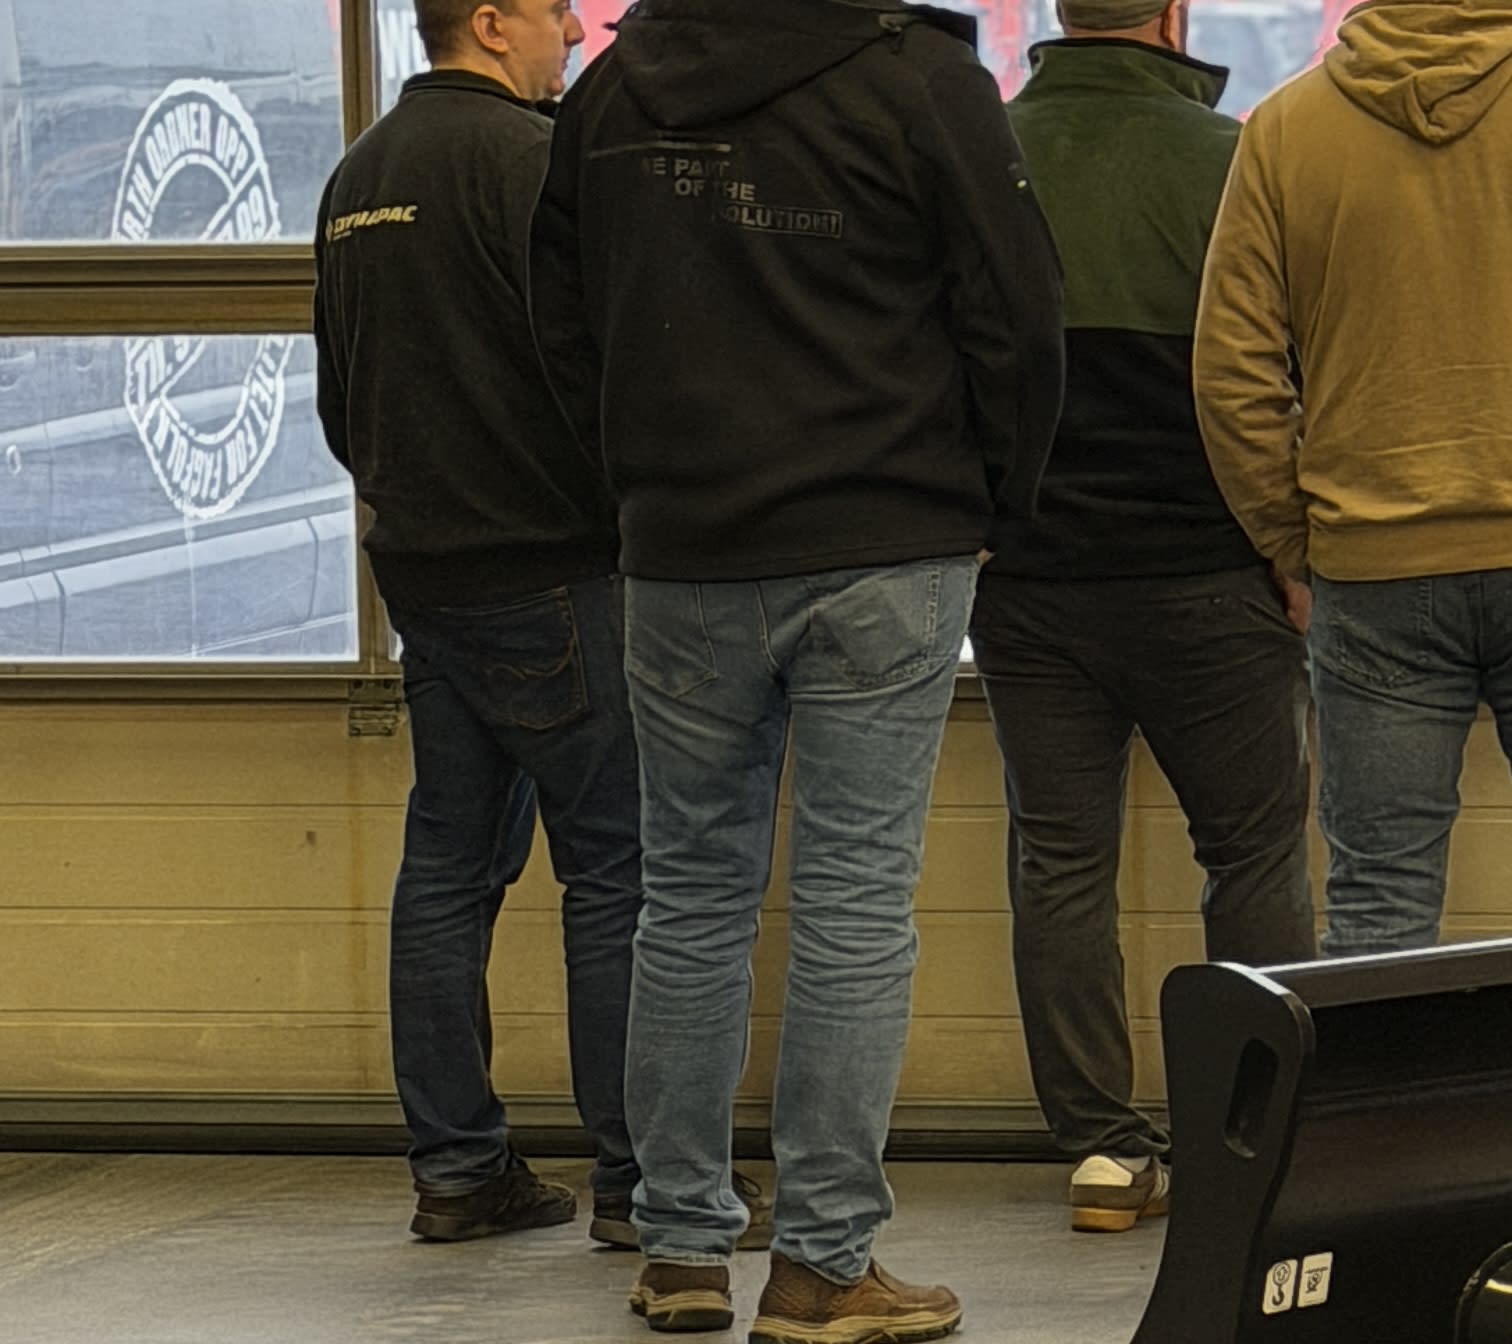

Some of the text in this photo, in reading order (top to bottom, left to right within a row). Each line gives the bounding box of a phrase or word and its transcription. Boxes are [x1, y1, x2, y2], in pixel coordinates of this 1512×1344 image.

[145, 102, 211, 181] ORDNER
[215, 114, 249, 180] OPP
[333, 204, 418, 235] DYNAPAC
[674, 177, 706, 198] OF
[152, 406, 223, 500] FAGFOLK
[225, 415, 259, 485] FOR
